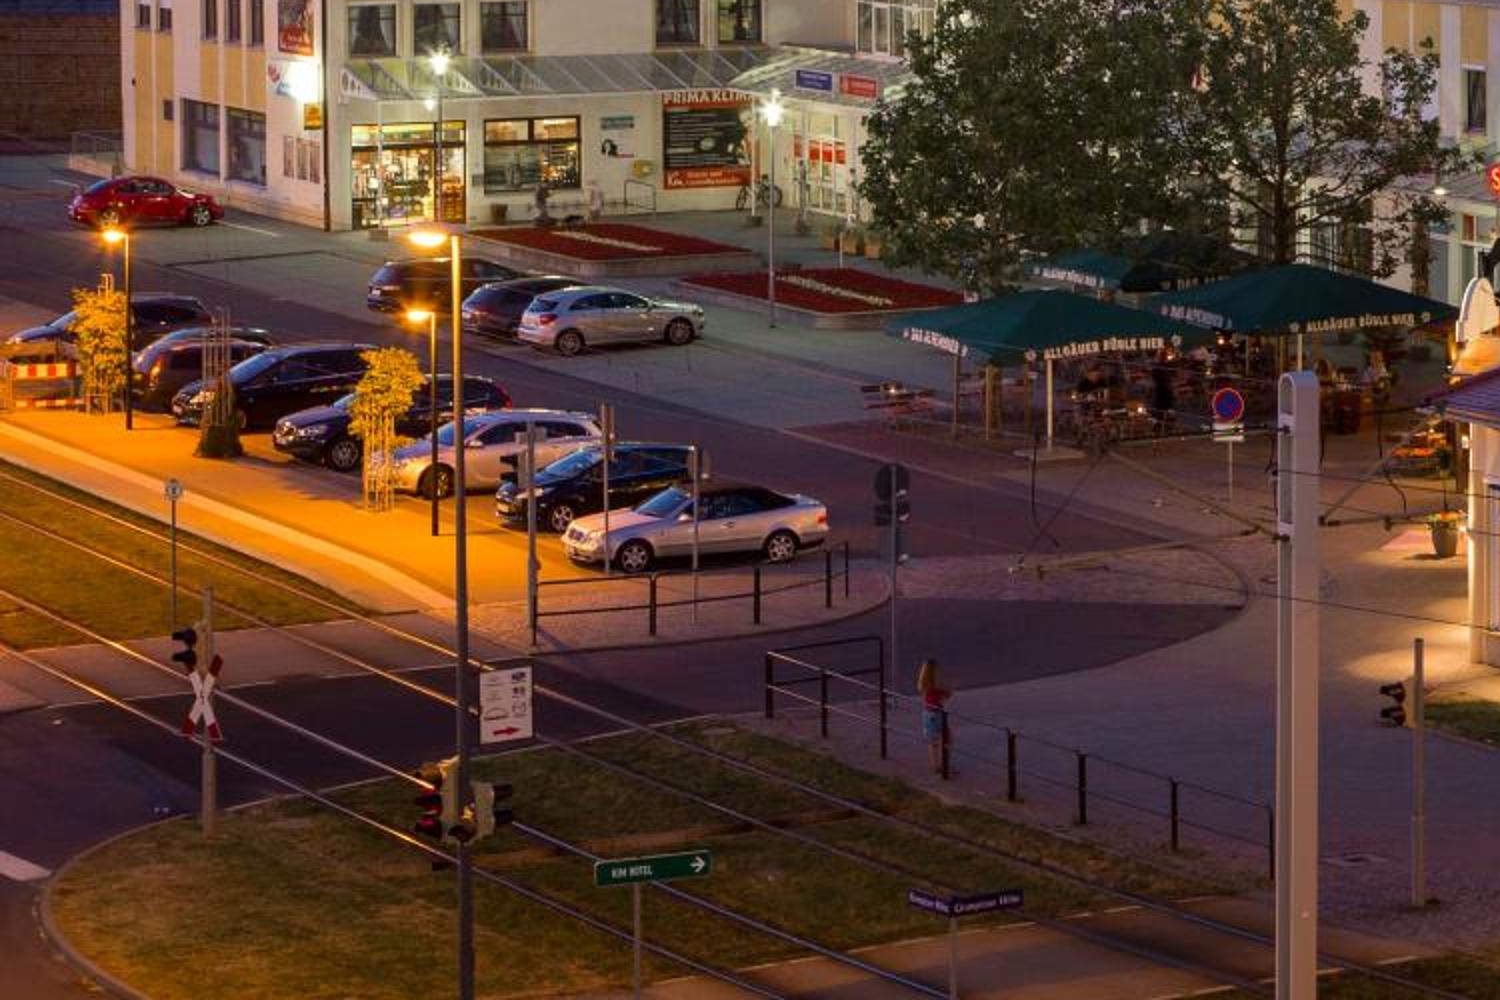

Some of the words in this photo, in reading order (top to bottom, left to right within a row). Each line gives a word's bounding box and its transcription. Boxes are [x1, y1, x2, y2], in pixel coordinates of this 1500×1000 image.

[663, 90, 712, 104] PRIMA
[611, 867, 627, 879] KIM
[629, 865, 653, 877] HOTEL
